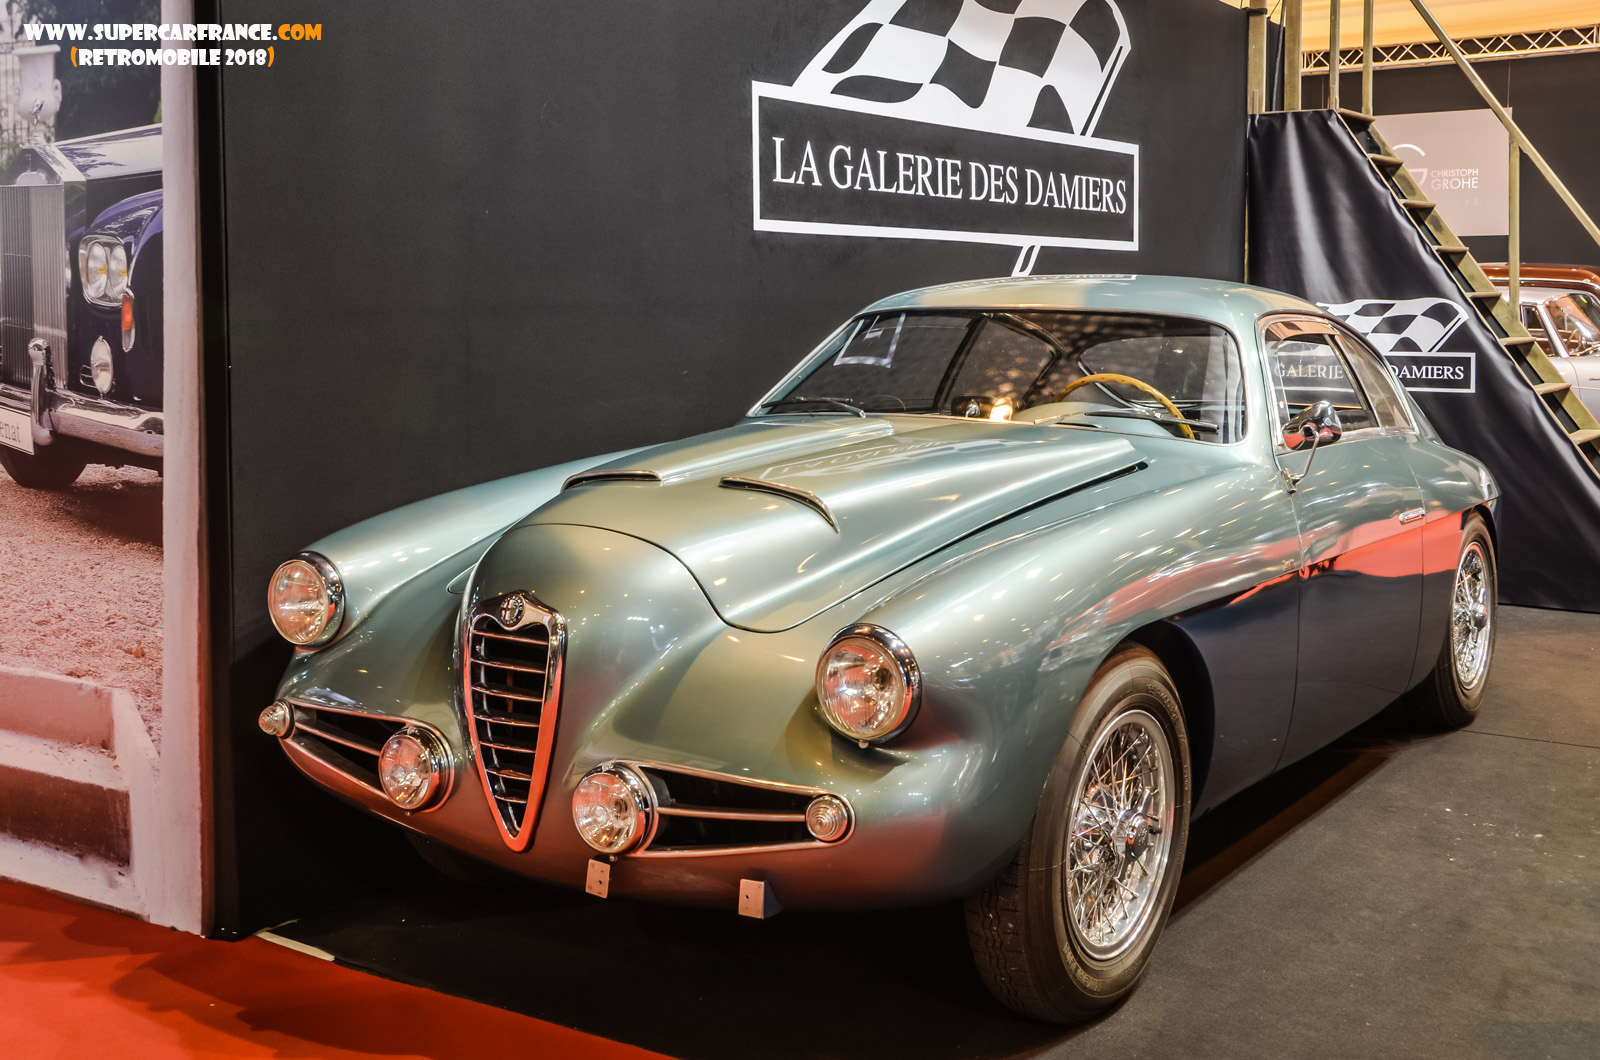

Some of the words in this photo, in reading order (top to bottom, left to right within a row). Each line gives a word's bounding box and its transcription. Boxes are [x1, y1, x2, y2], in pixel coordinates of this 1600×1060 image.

[772, 136, 822, 187] LA
[829, 144, 963, 200] GALERIE
[968, 161, 1019, 205] DES
[1025, 170, 1127, 214] DAMIERS
[1430, 168, 1479, 178] CHRISTOPH
[1430, 177, 1479, 190] GROHE
[1273, 362, 1344, 379] GALERIE
